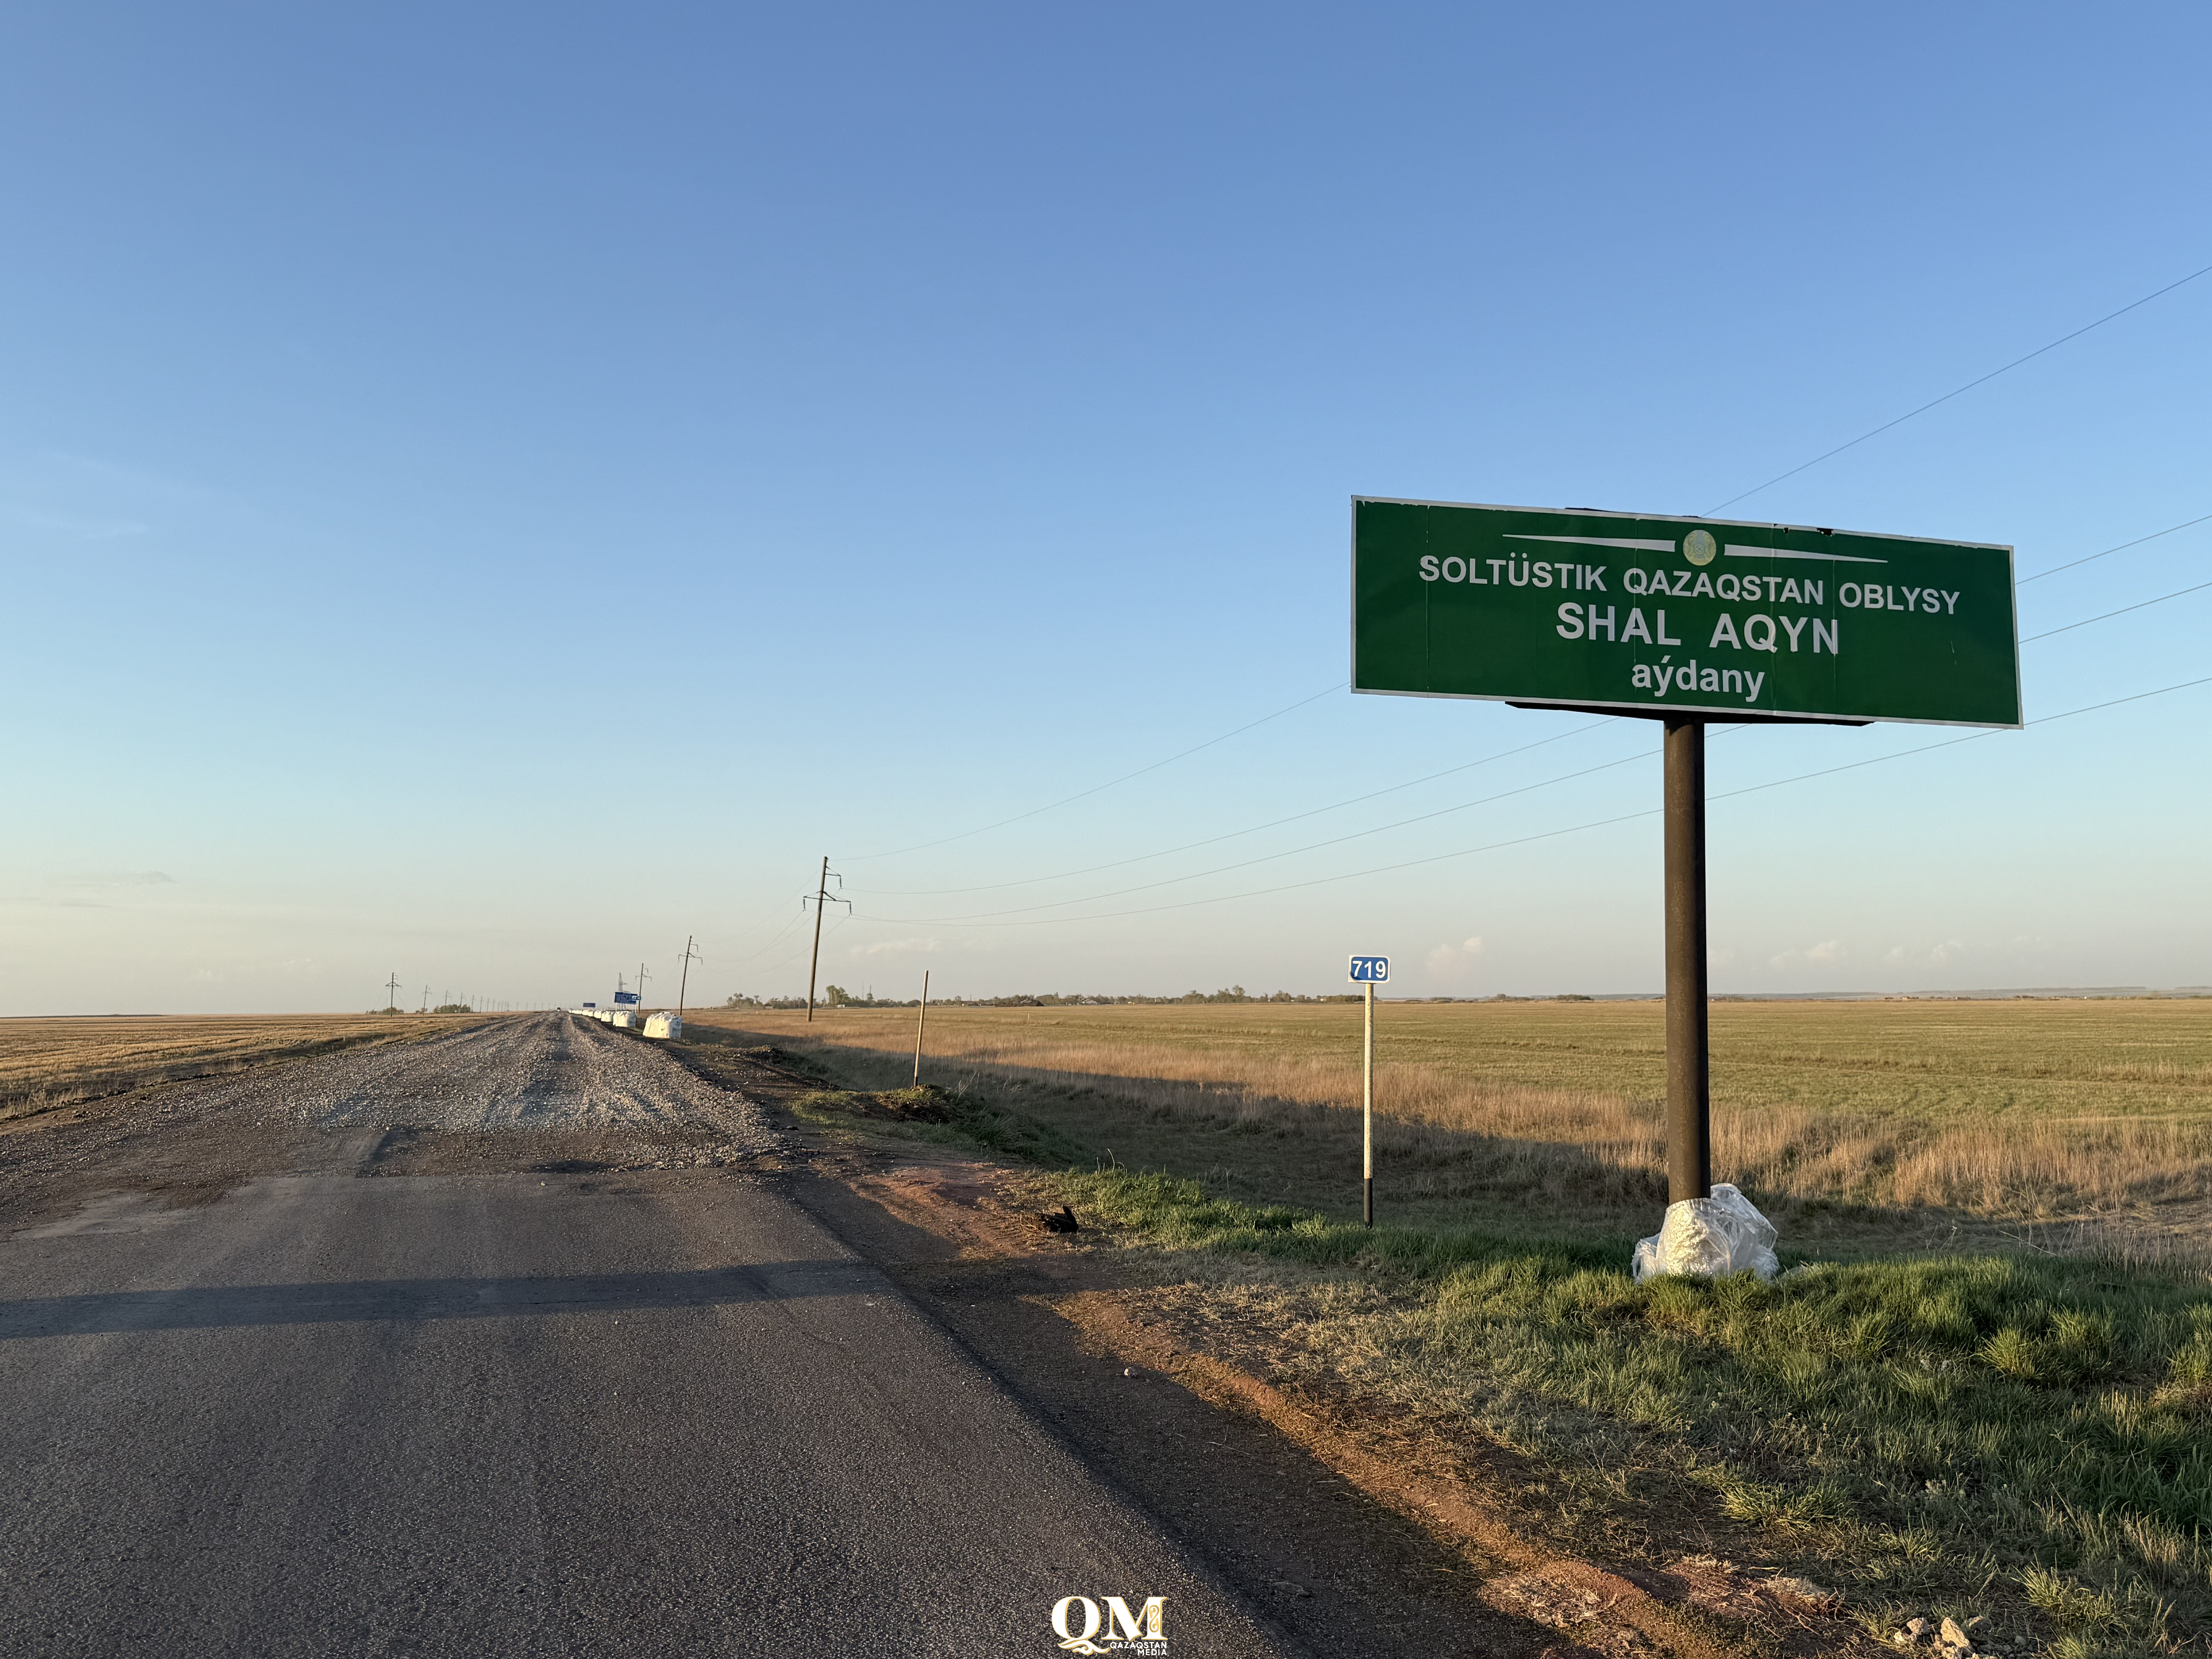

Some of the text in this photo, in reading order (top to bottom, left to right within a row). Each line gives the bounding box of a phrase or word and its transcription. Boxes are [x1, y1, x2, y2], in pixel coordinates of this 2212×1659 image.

[1419, 551, 1960, 615] SOLTÜSTIK QAZAQSTAN OBLYSY
[1556, 602, 1839, 656] SHAL AQYN
[1631, 654, 1765, 702] aýdany
[1352, 960, 1386, 978] 719
